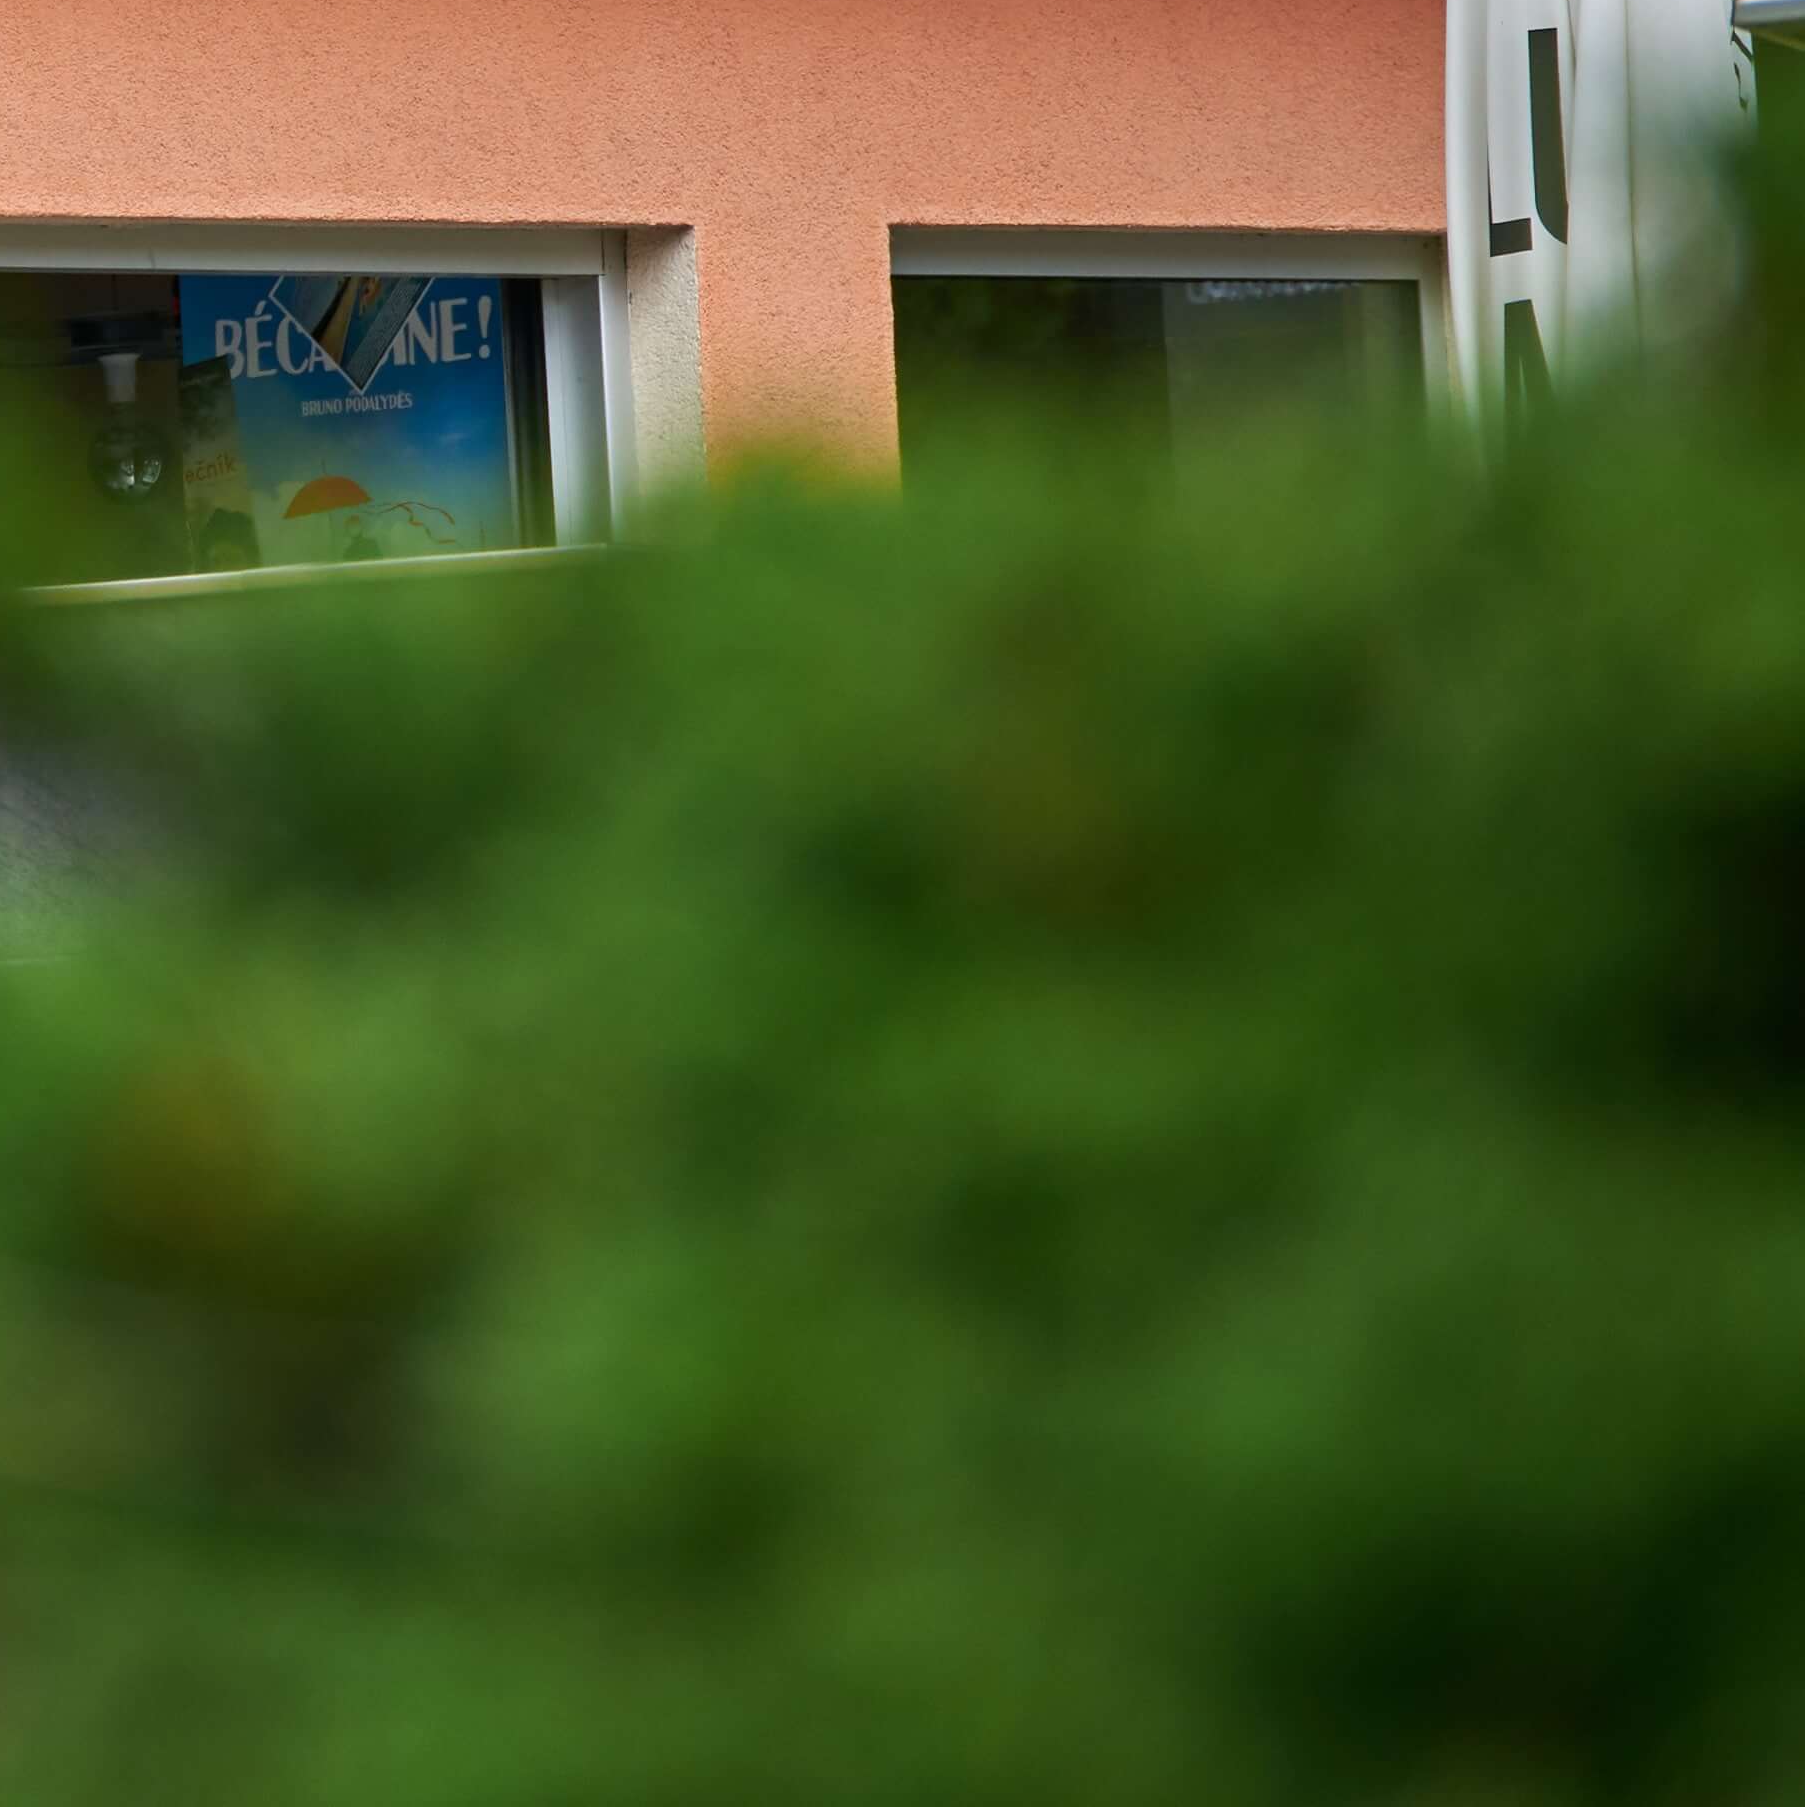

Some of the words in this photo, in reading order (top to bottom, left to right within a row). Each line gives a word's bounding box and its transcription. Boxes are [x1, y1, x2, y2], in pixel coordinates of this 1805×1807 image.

[214, 295, 492, 381] BÉCAINE!
[301, 399, 343, 417] BRUNO
[185, 453, 238, 483] ečník
